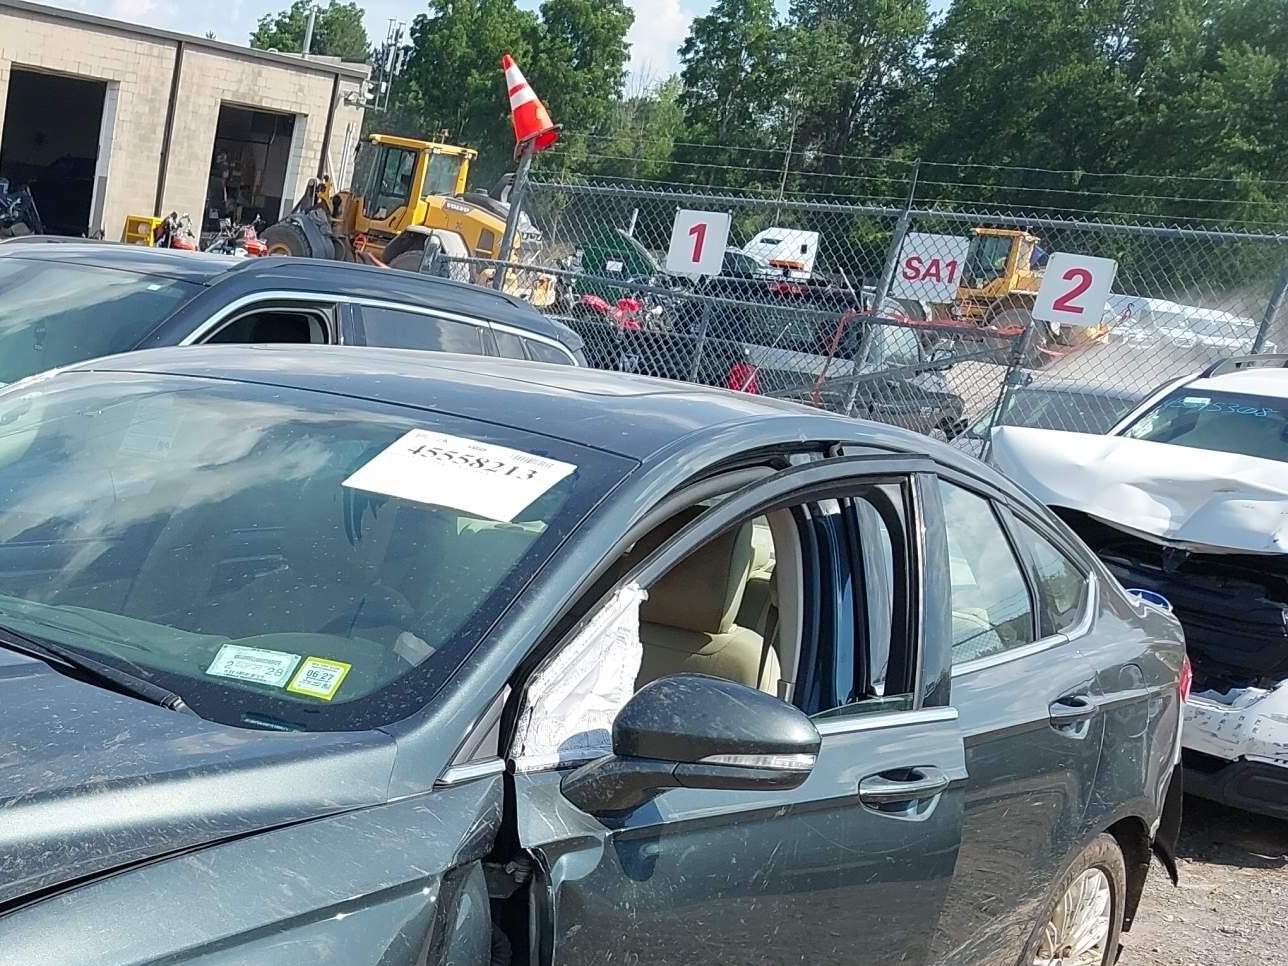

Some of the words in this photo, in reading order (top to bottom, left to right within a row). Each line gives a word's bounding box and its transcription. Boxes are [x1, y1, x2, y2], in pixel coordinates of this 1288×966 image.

[688, 223, 708, 263] 1
[902, 255, 958, 284] SA1
[1052, 267, 1094, 314] 2
[407, 444, 537, 480] 45558213
